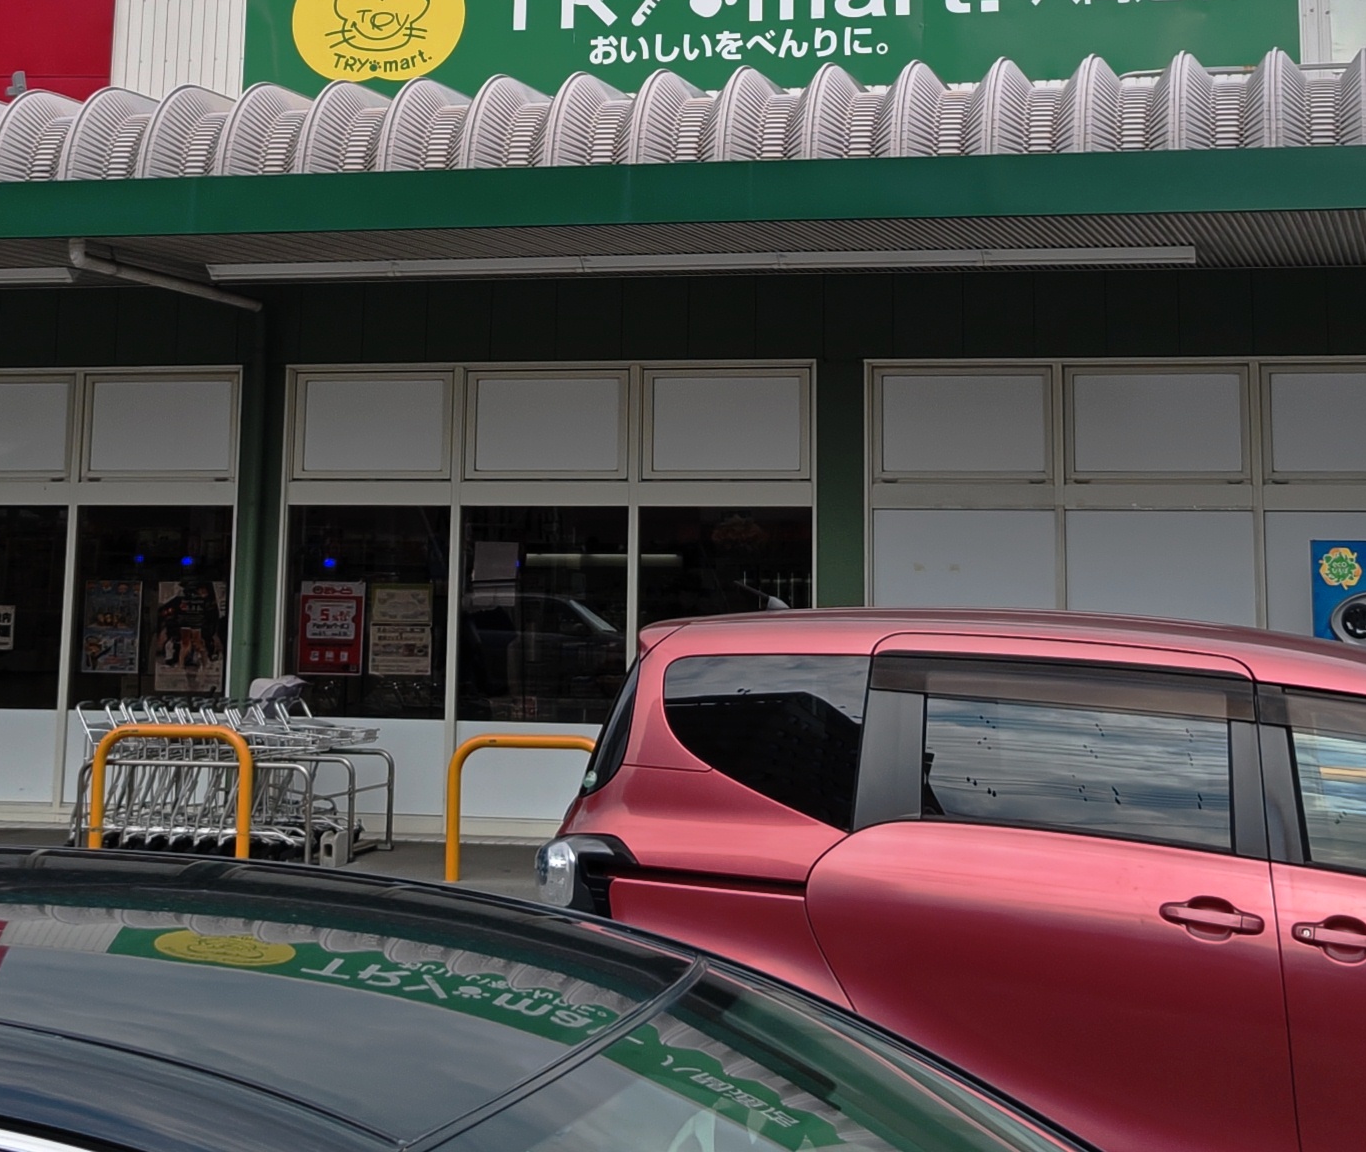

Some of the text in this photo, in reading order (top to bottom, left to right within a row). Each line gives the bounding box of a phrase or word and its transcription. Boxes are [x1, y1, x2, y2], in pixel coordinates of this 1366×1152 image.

[589, 26, 890, 66] おいしいをべんりに。
